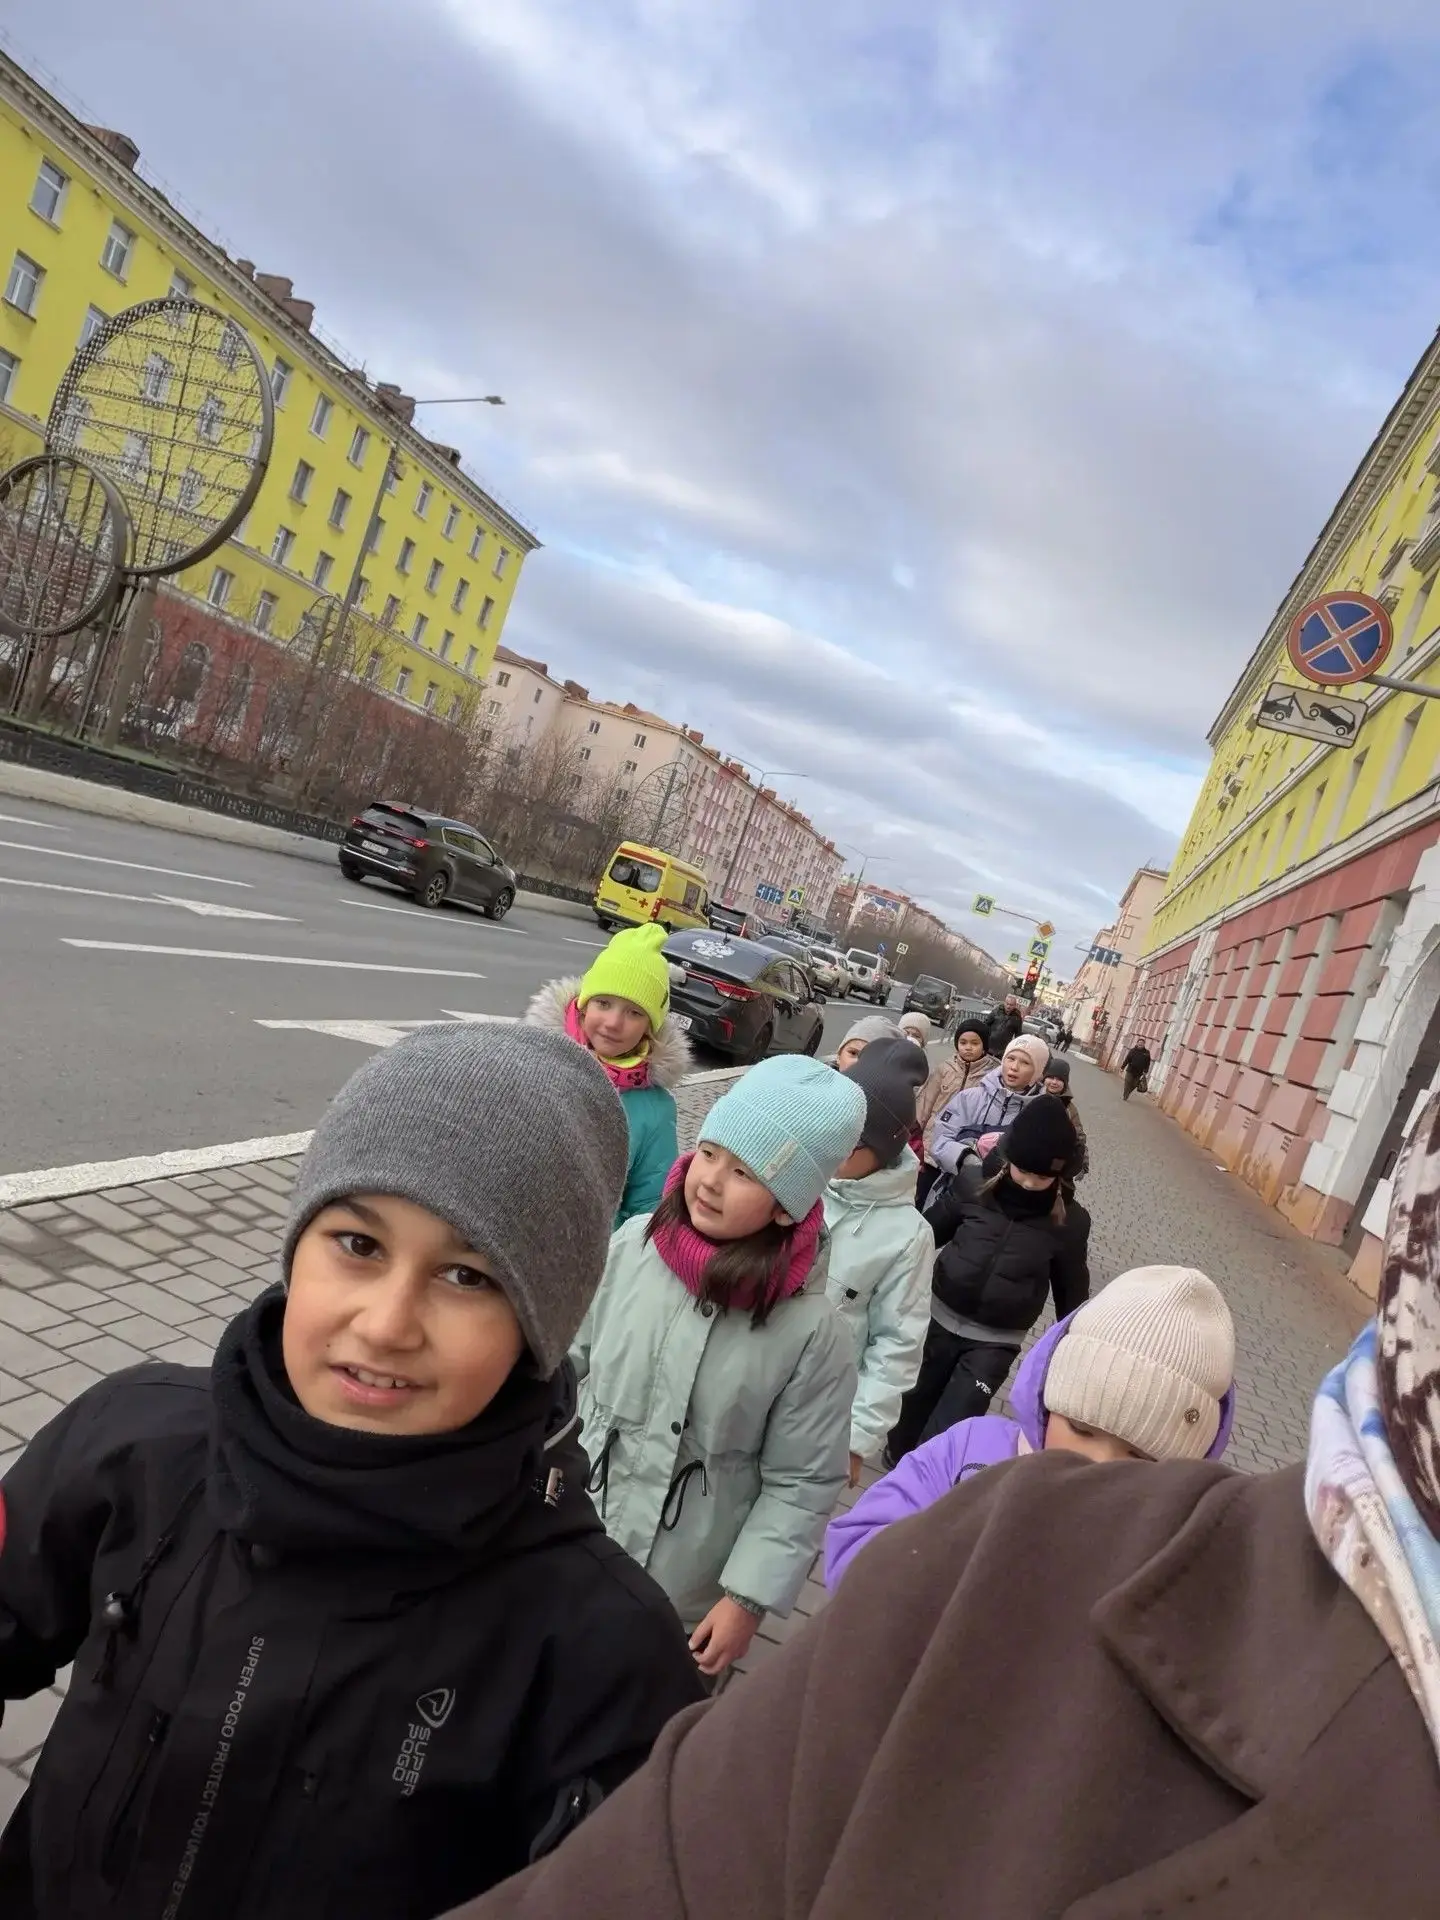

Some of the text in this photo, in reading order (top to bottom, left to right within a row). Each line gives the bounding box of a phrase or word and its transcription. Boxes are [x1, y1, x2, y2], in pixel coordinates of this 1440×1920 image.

[237, 1636, 265, 1687] SUPER
[220, 1690, 246, 1738] POGO
[200, 1741, 231, 1807] PROTECT
[392, 1722, 420, 1782] POGO
[400, 1727, 431, 1797] SUPER
[191, 1811, 211, 1838] YOU
